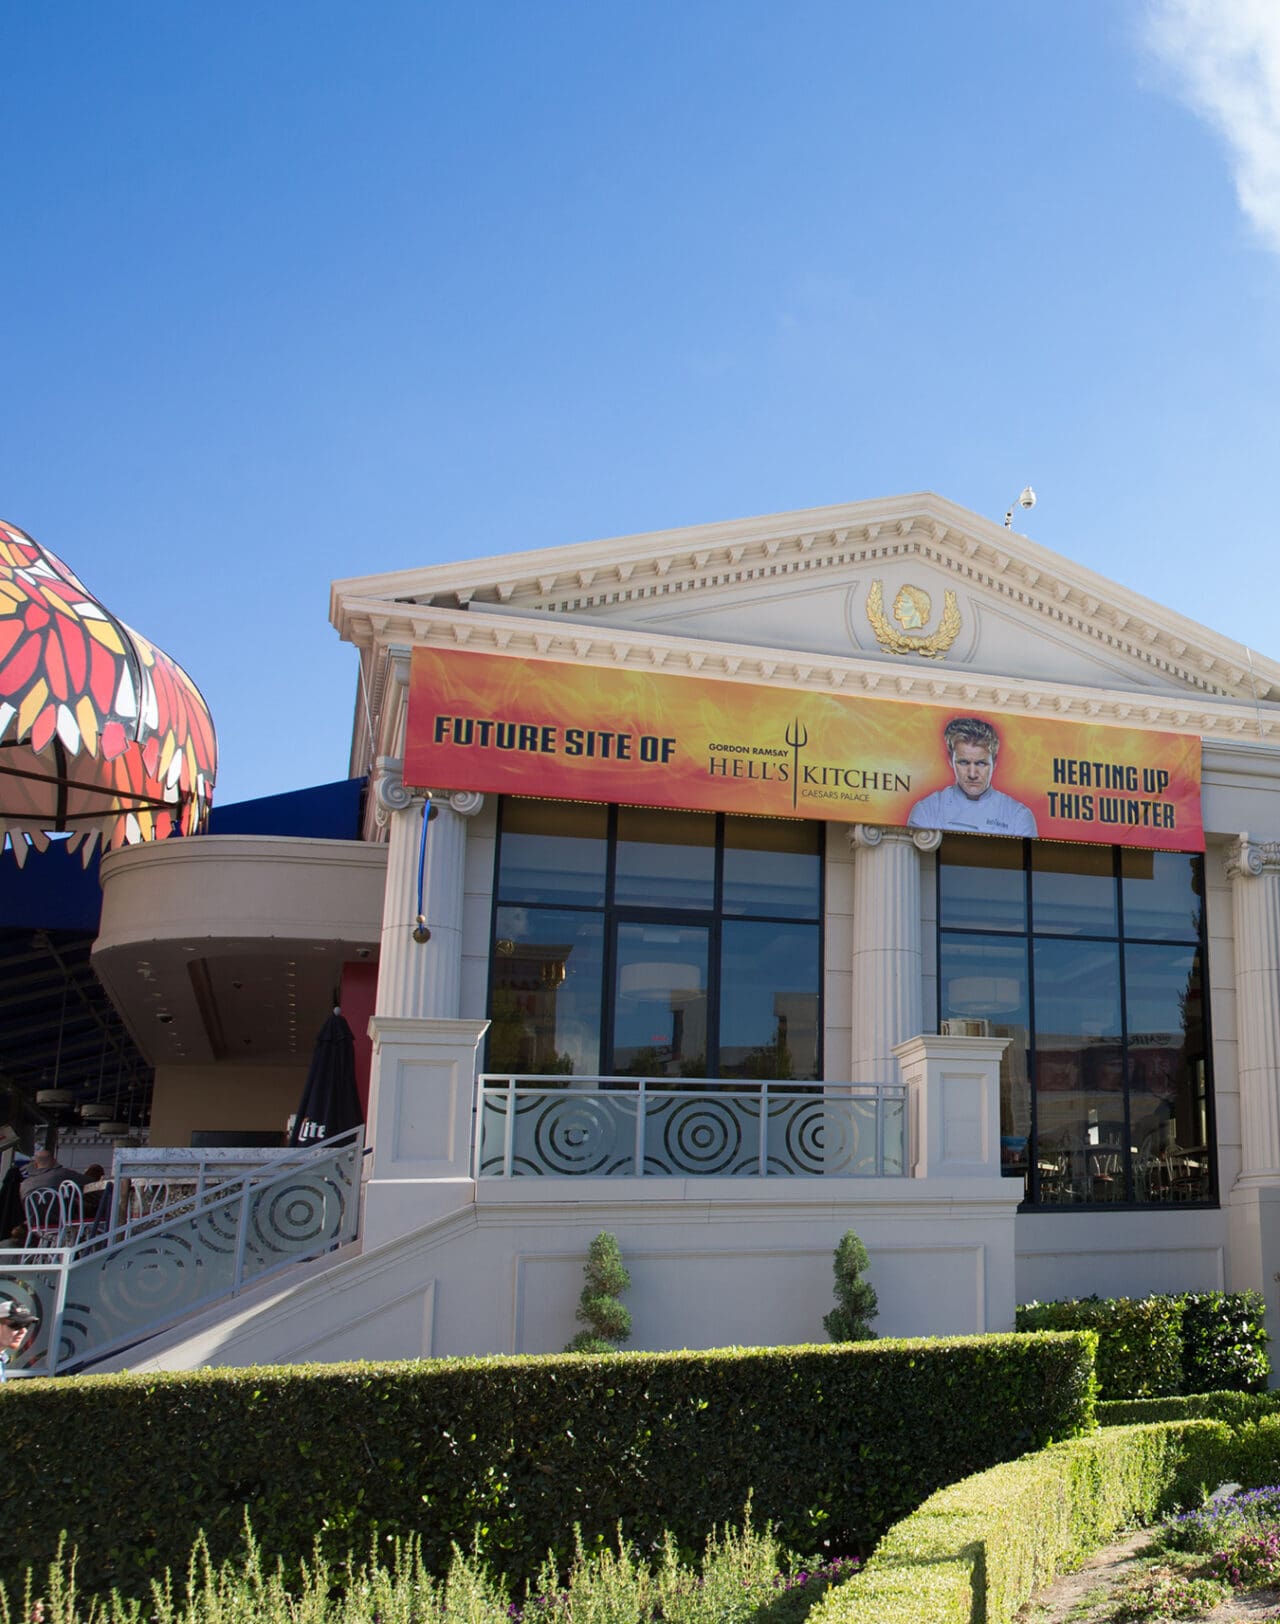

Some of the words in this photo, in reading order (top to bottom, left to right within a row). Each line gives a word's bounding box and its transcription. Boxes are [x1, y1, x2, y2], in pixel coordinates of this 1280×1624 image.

[434, 716, 556, 754] FUTURE
[565, 728, 631, 760] SITE
[639, 736, 676, 763] OF
[709, 743, 750, 754] GORDON
[752, 747, 788, 758] RAMSAY
[709, 757, 789, 782] HELL'S
[803, 765, 911, 792] KITCHEN
[1053, 758, 1137, 791] HEATING
[1143, 768, 1169, 794] UP
[801, 789, 838, 800] CAESARS
[840, 792, 870, 802] PALACE
[1047, 791, 1094, 821] THIS
[1099, 797, 1175, 829] WINTER
